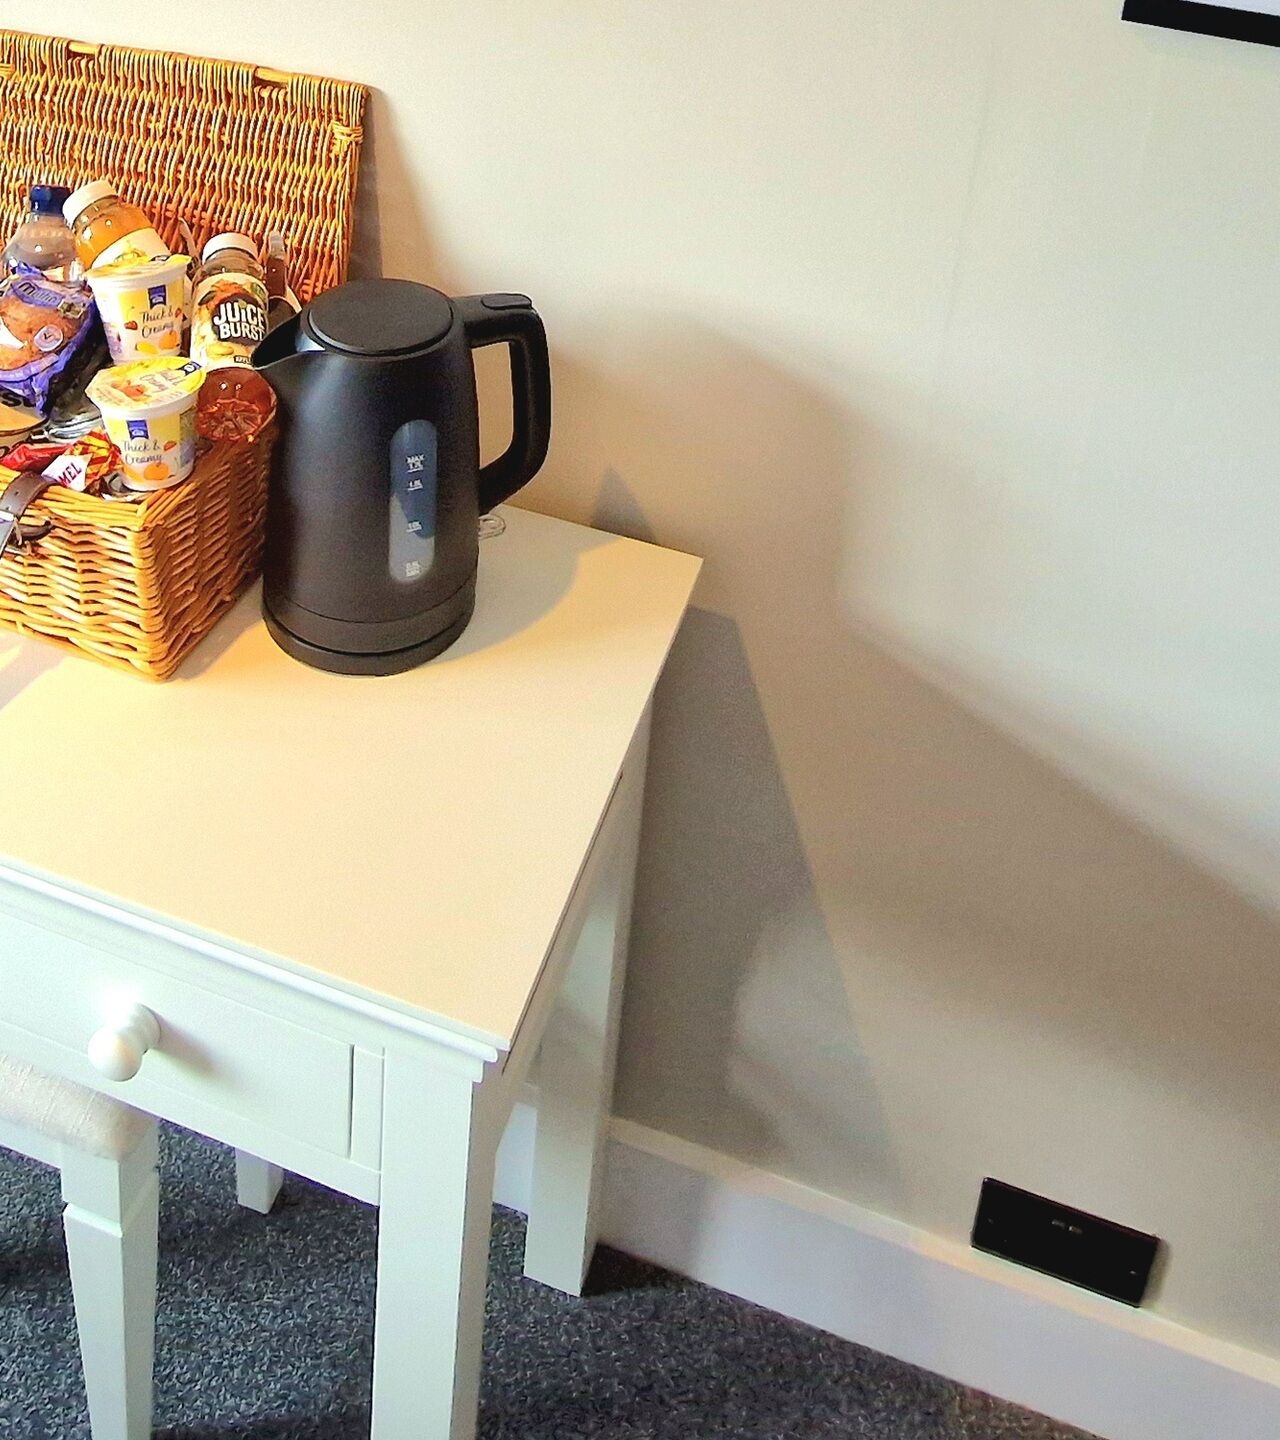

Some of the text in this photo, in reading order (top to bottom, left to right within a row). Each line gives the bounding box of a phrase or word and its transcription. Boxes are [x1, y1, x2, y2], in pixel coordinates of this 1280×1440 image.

[219, 322, 265, 341] BURST
[124, 441, 148, 453] Thick
[125, 453, 162, 465] Creamy
